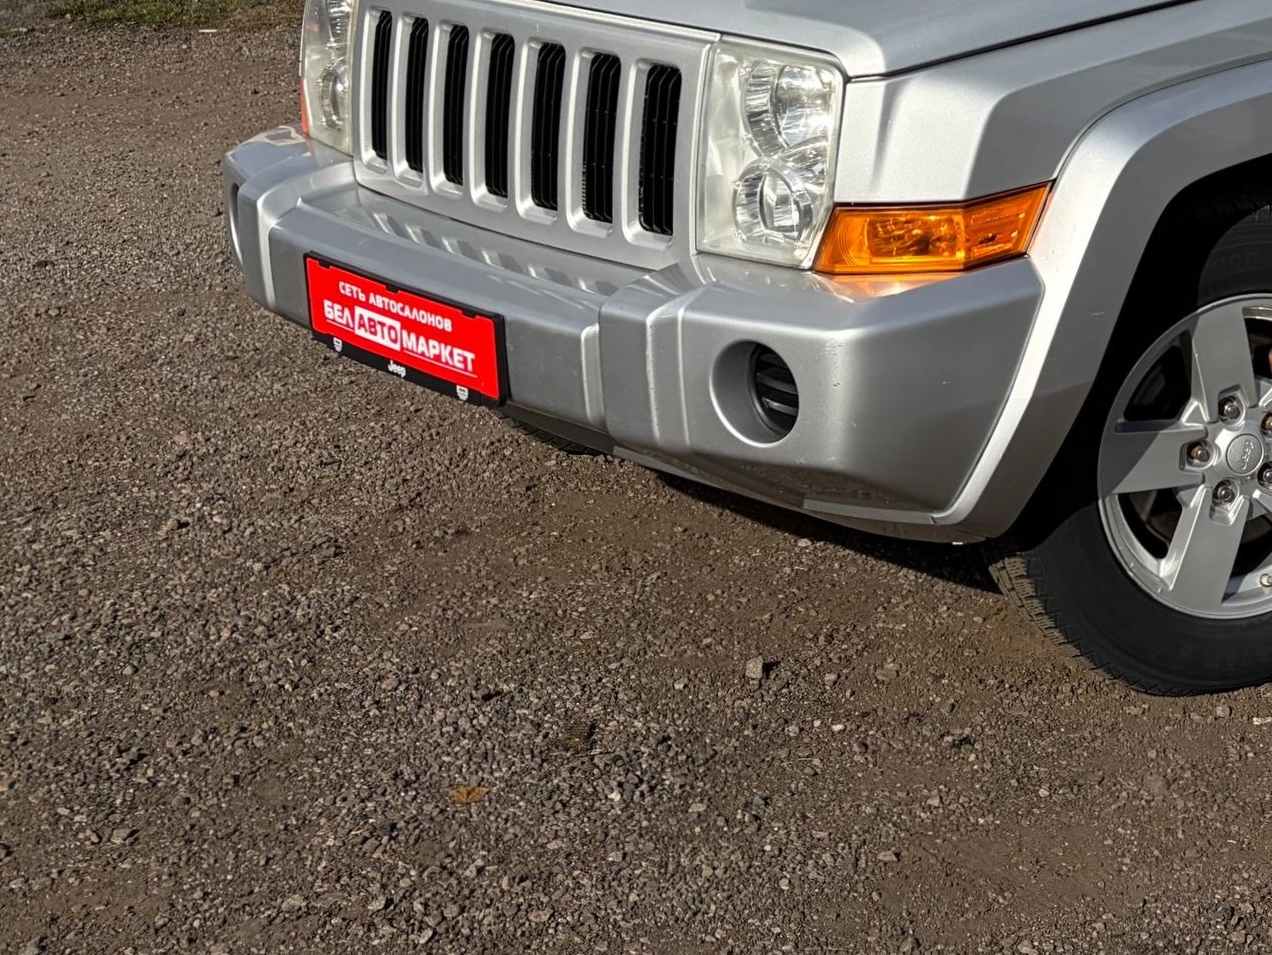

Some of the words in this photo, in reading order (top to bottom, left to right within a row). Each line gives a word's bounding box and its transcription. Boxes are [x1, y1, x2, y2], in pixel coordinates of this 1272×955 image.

[338, 280, 366, 303] СЕТЬ
[368, 292, 453, 333] АВТОСАЛОНОВ
[323, 298, 354, 329] БЕЛ
[357, 316, 400, 344] АВТО
[402, 329, 476, 372] МАРКЕТ
[387, 359, 407, 378] Jeep
